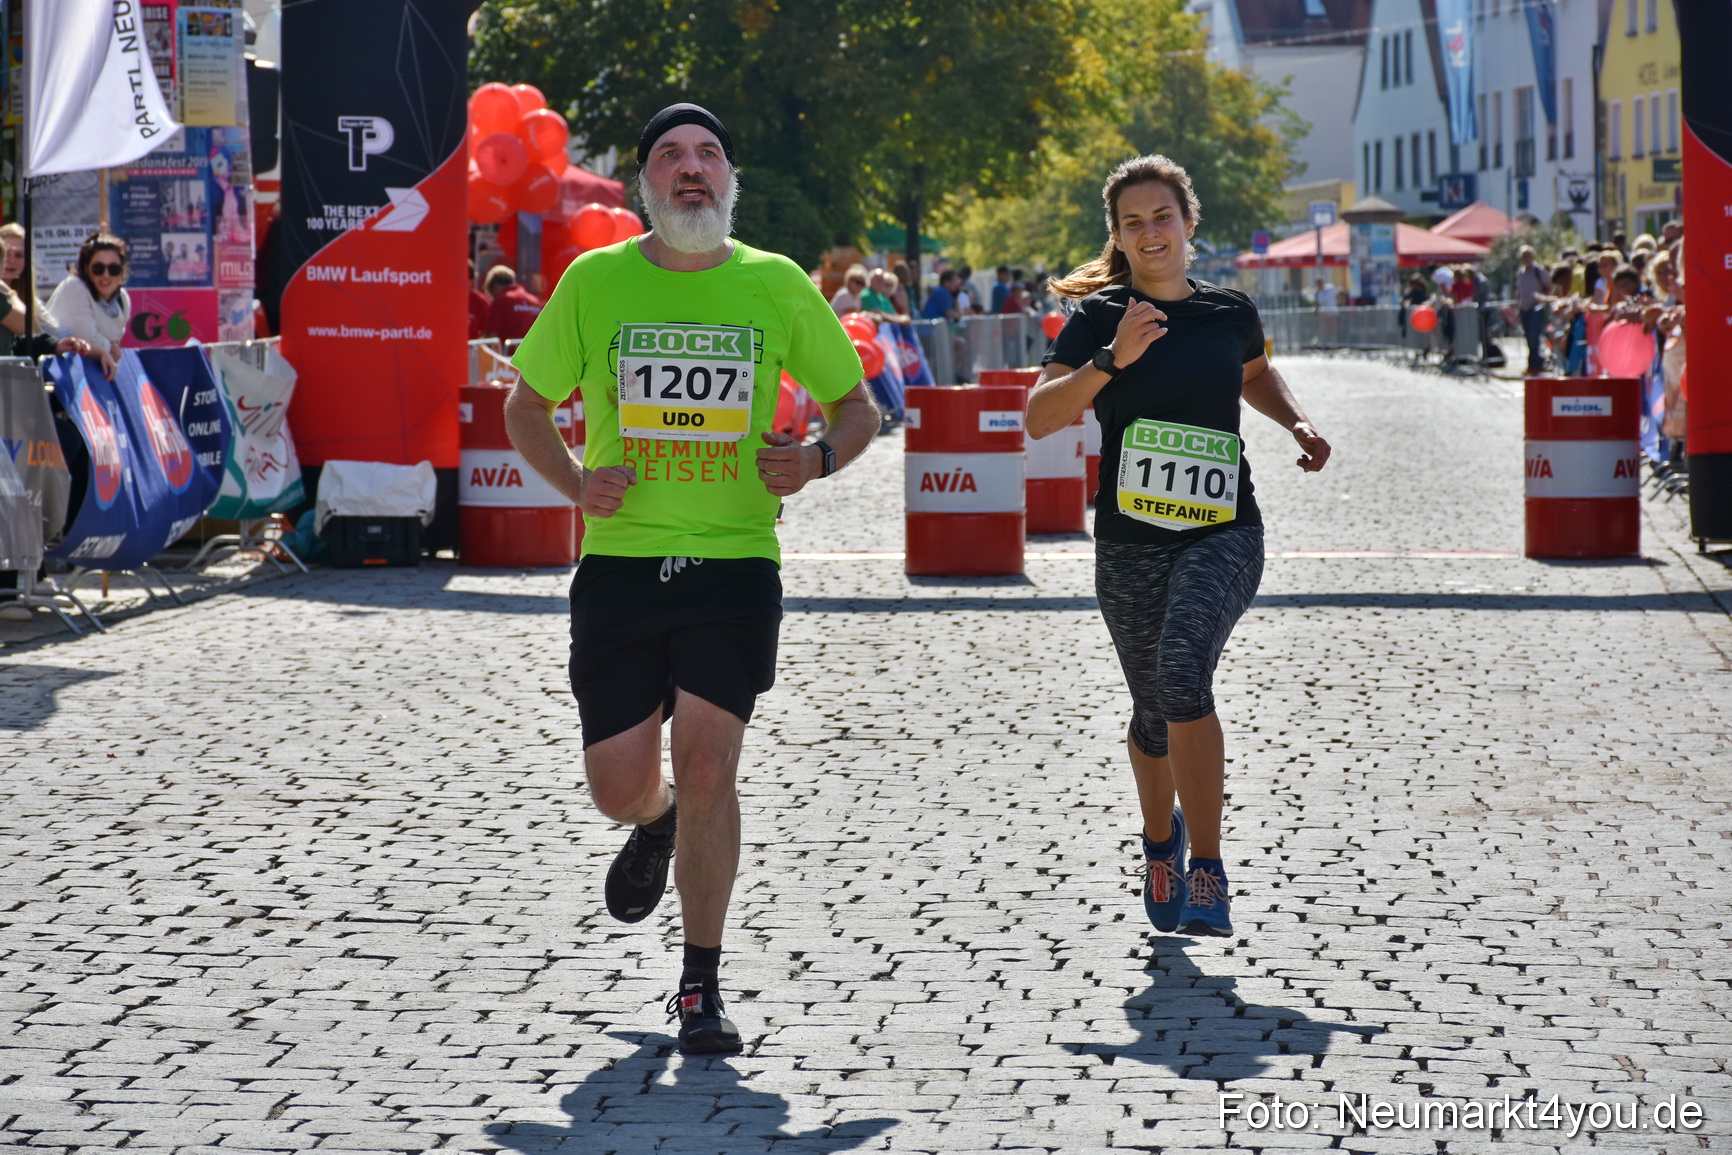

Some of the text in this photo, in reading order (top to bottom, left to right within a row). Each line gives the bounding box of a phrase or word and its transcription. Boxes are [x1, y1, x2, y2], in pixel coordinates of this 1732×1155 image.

[127, 57, 160, 139] PARTL
[322, 204, 381, 219] THE NEXT
[306, 217, 366, 231] 100 YEARS
[306, 265, 432, 287] BMW Laufsport
[307, 325, 433, 341] www.bmw-partl.de
[629, 328, 743, 358] BOCK
[634, 364, 738, 402] 1207
[193, 388, 218, 406] STORE
[188, 419, 222, 438] ONLINE
[662, 411, 705, 427] UDO
[623, 436, 738, 459] PREMIUM
[1132, 423, 1231, 461] BOCK
[1136, 457, 1226, 499] 1110
[1133, 497, 1219, 523] STEFANIE
